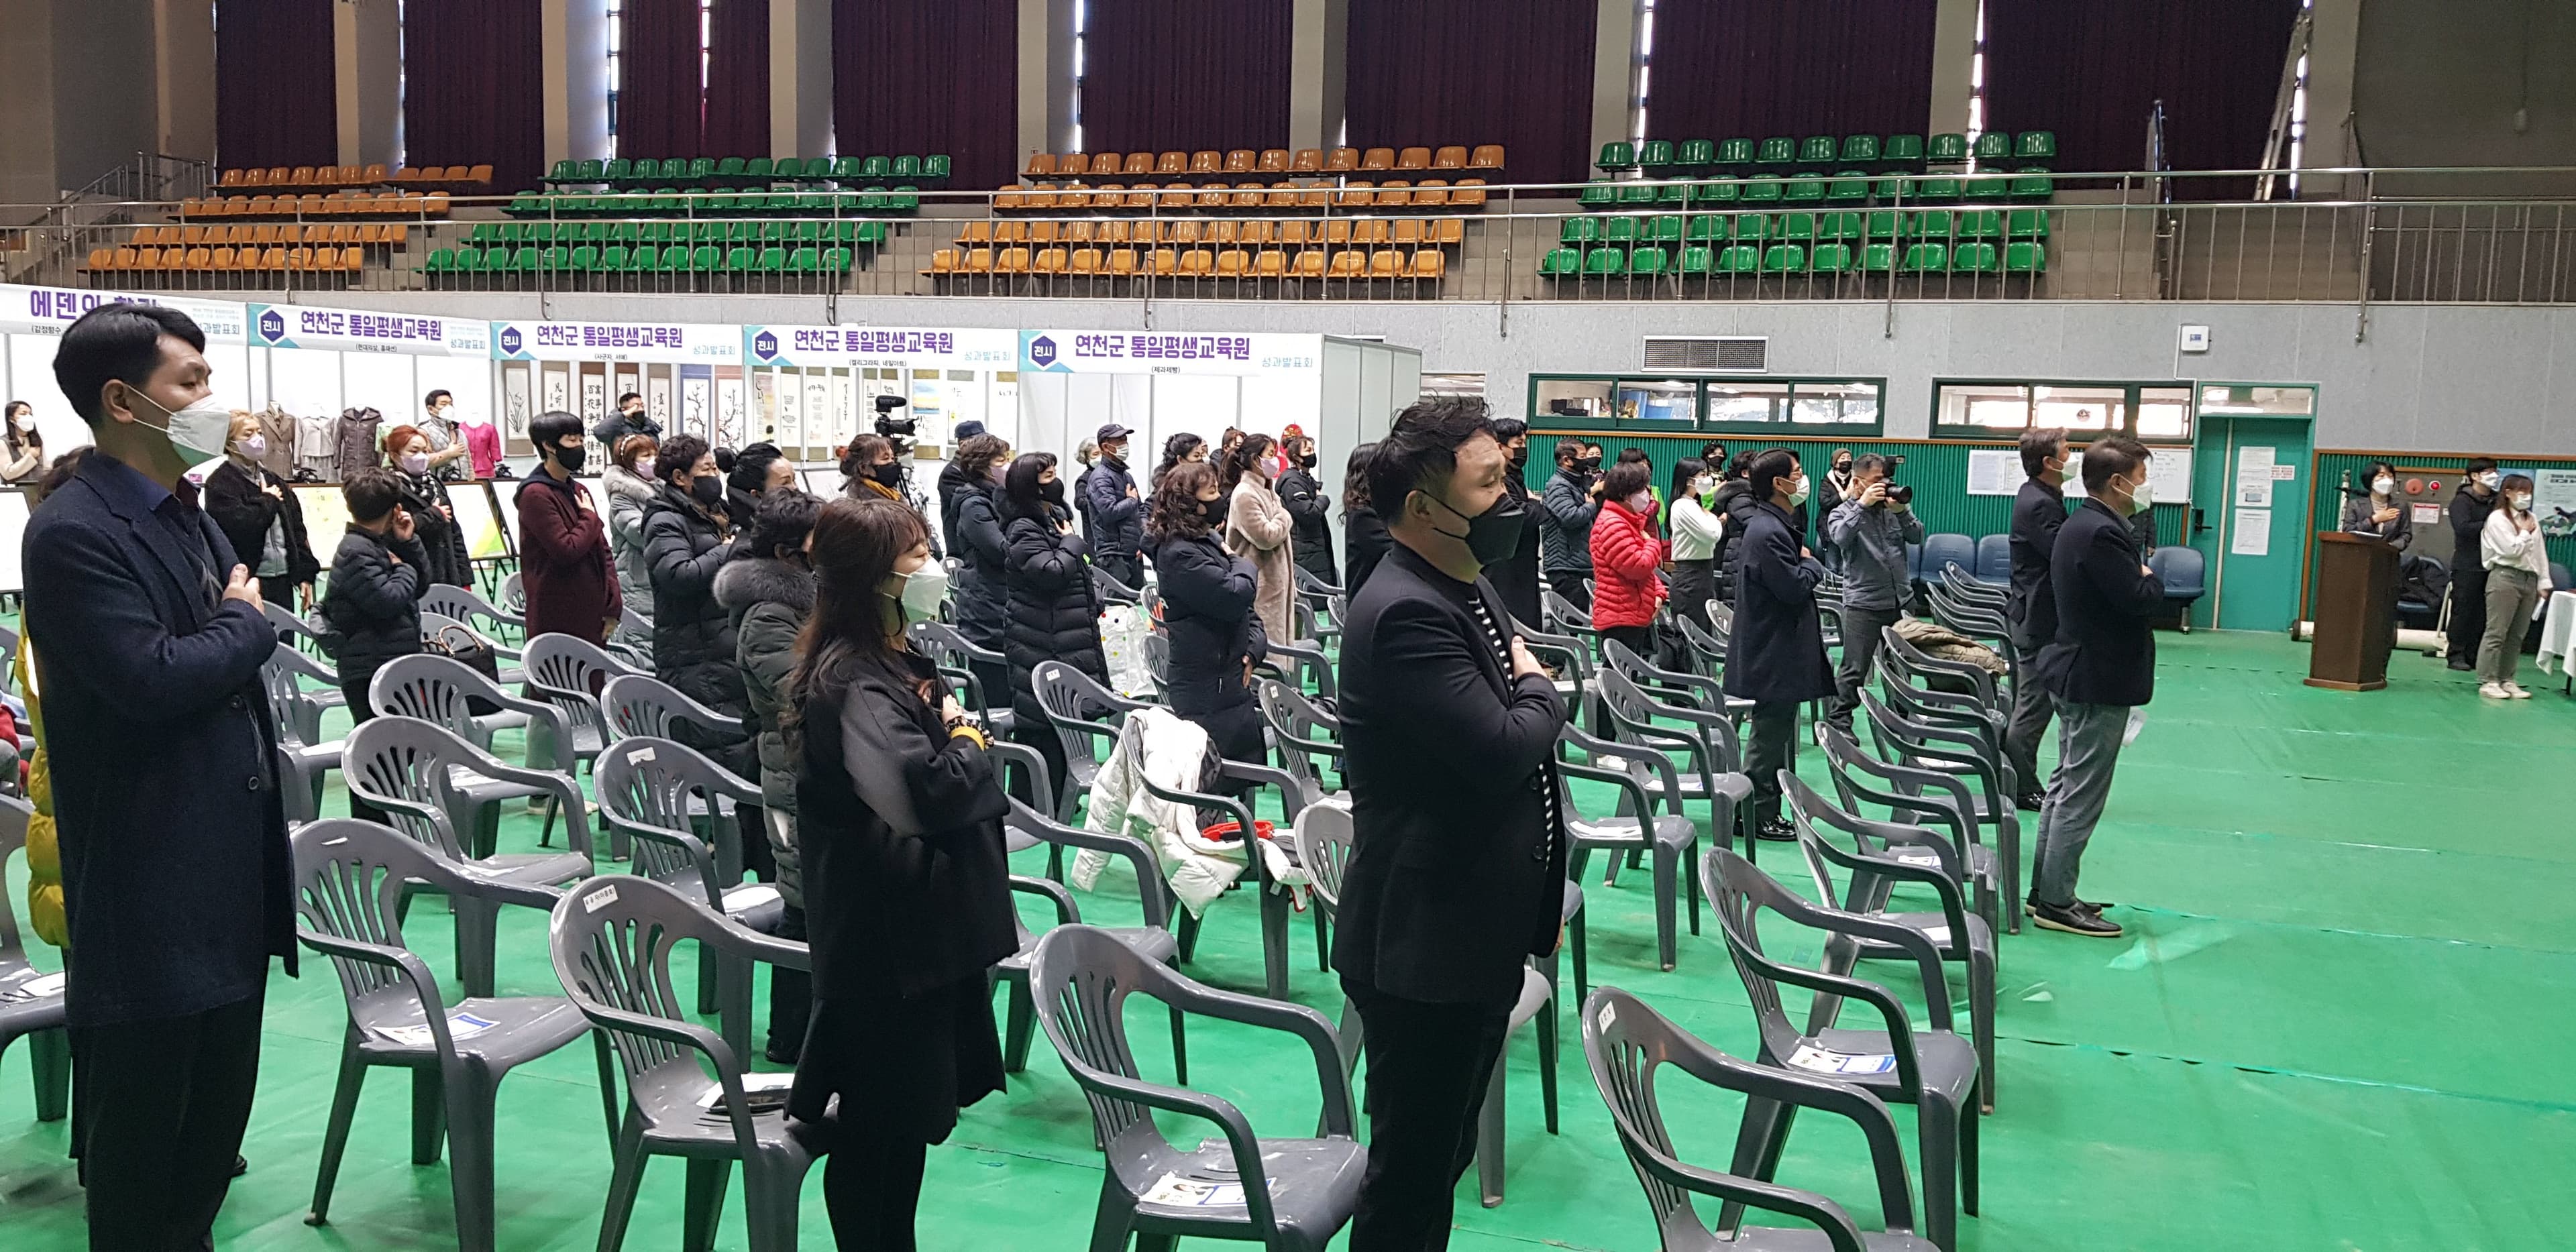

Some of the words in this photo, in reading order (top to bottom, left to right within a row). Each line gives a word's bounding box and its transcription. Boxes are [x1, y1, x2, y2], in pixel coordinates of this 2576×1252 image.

[30, 290, 101, 320] 에덴의
[199, 322, 240, 335] 과발표회
[263, 320, 281, 333] 전시
[301, 311, 344, 335] 연천군
[349, 315, 442, 341] 통일평생교육원
[502, 335, 519, 346] 전시
[537, 325, 578, 346] 연천군
[583, 327, 683, 348] 통일평생교육원
[794, 330, 840, 352] 연천군
[845, 331, 953, 354] 통일평생교육원
[450, 337, 486, 349] 성과발표회
[757, 341, 775, 351] 전시
[1075, 335, 1125, 357] 연천군
[1130, 336, 1251, 360] 통일평생교육원
[693, 345, 736, 355] 성과발표회
[964, 351, 1011, 361] 성과발표회
[1034, 345, 1052, 357] 전시
[1262, 357, 1313, 368] 성과발표회
[1151, 365, 1181, 375] (제과제빵)
